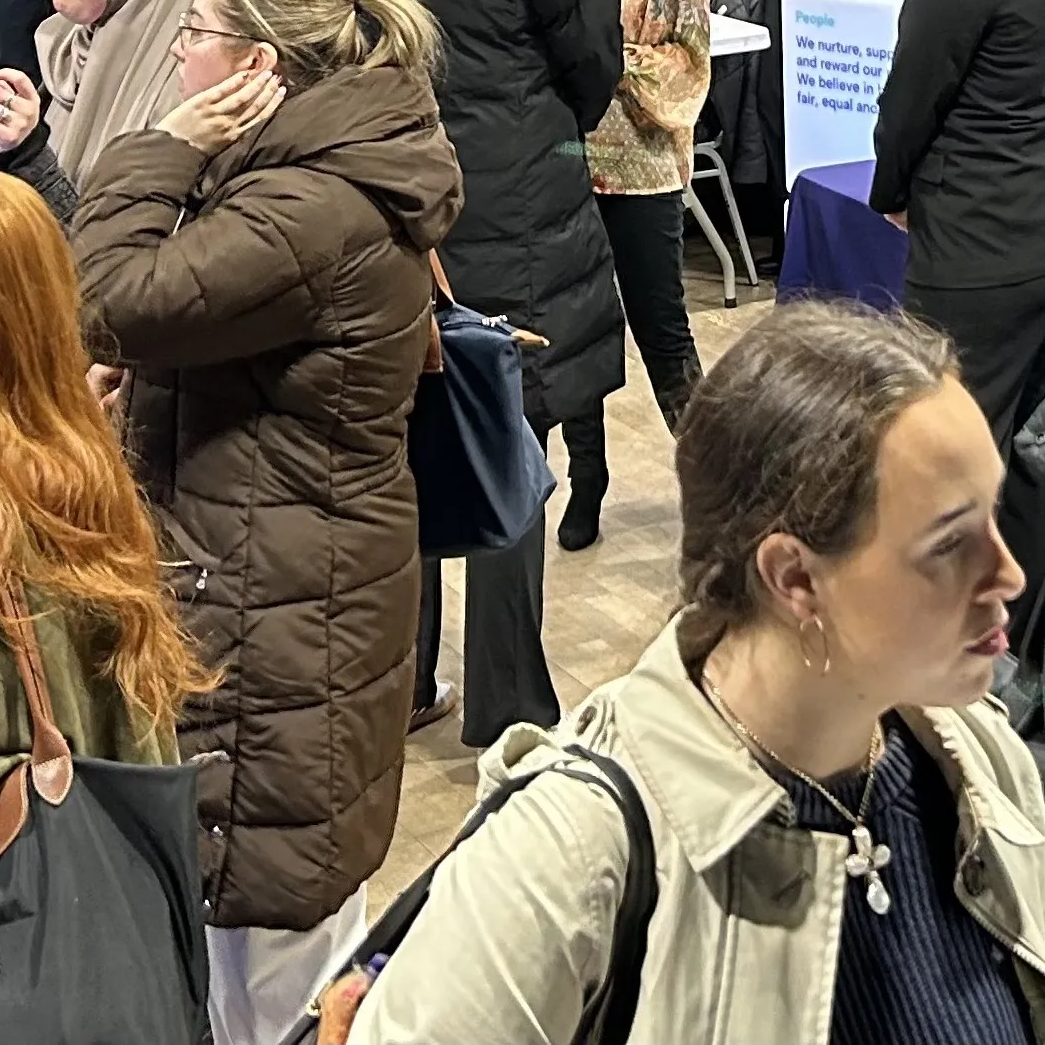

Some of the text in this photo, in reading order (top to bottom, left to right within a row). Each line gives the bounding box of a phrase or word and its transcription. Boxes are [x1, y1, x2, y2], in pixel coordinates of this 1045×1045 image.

[796, 10, 835, 28] People
[796, 35, 894, 61] We nurture, supp
[796, 56, 882, 77] and reward our
[797, 72, 815, 87] We
[819, 75, 860, 93] believe
[863, 81, 874, 94] in
[797, 90, 818, 107] fair,
[822, 97, 853, 111] equal
